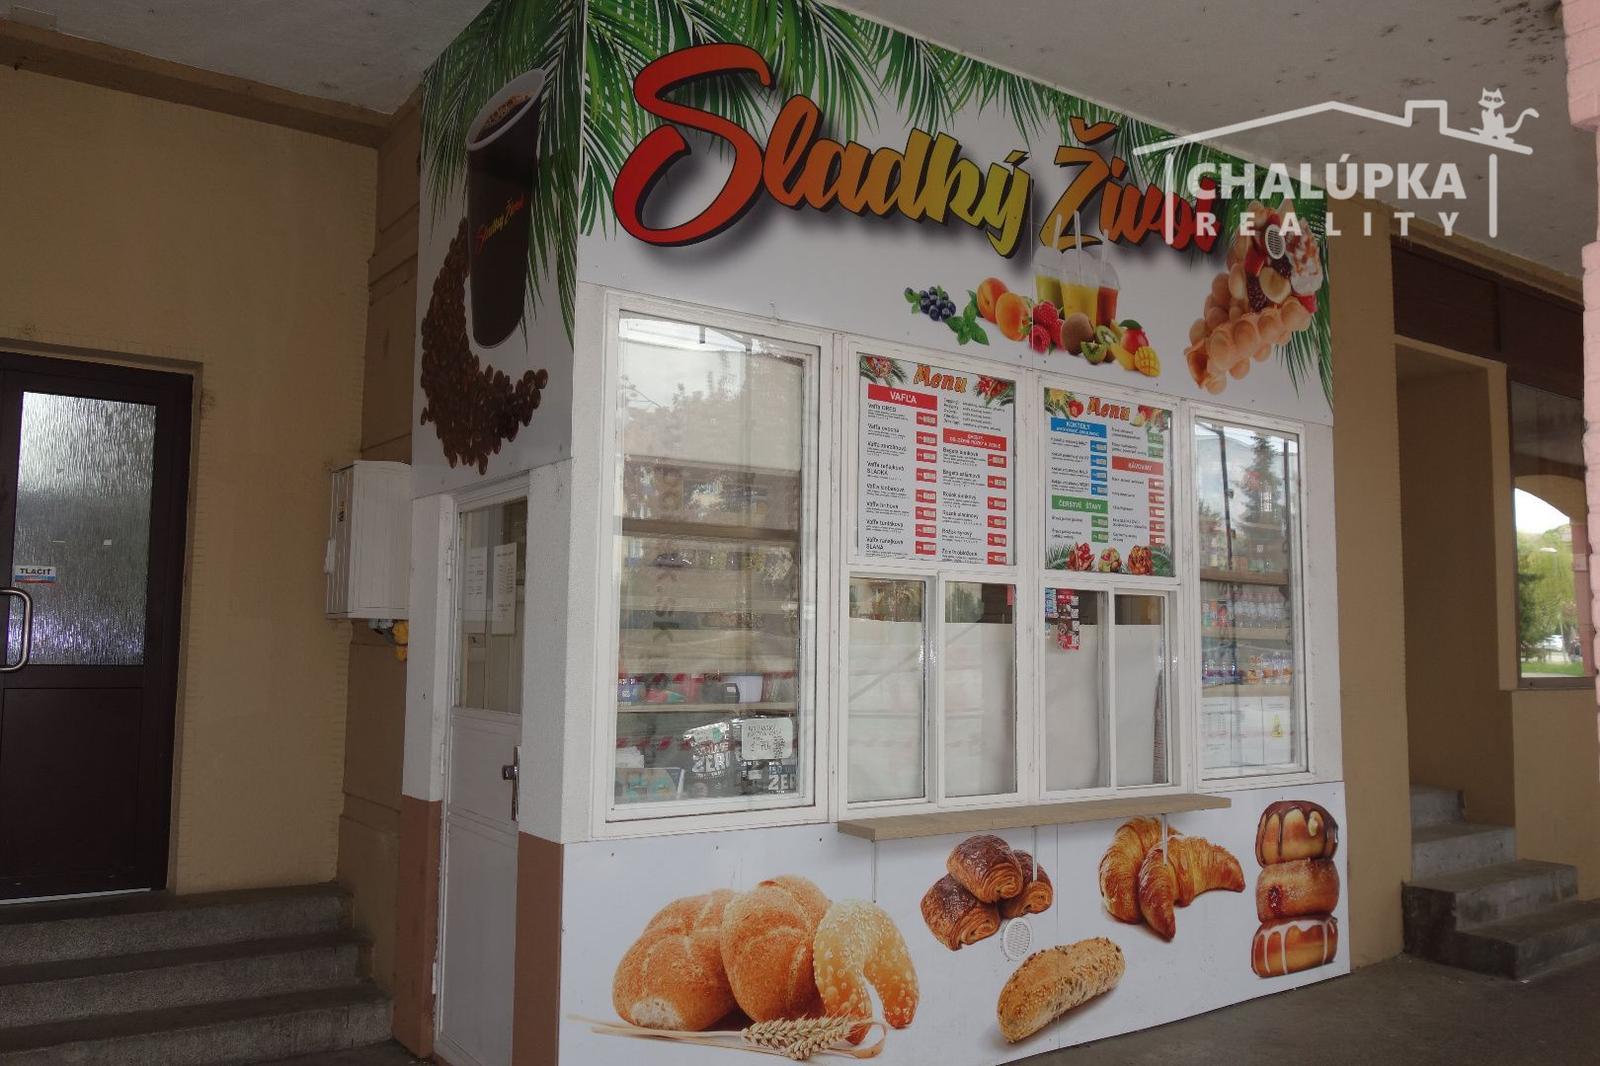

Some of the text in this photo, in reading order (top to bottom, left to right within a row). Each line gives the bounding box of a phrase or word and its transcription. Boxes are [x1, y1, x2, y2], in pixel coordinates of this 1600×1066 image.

[613, 43, 1221, 258] Sladký Život
[913, 363, 968, 394] Menu
[1087, 395, 1131, 422] Menu
